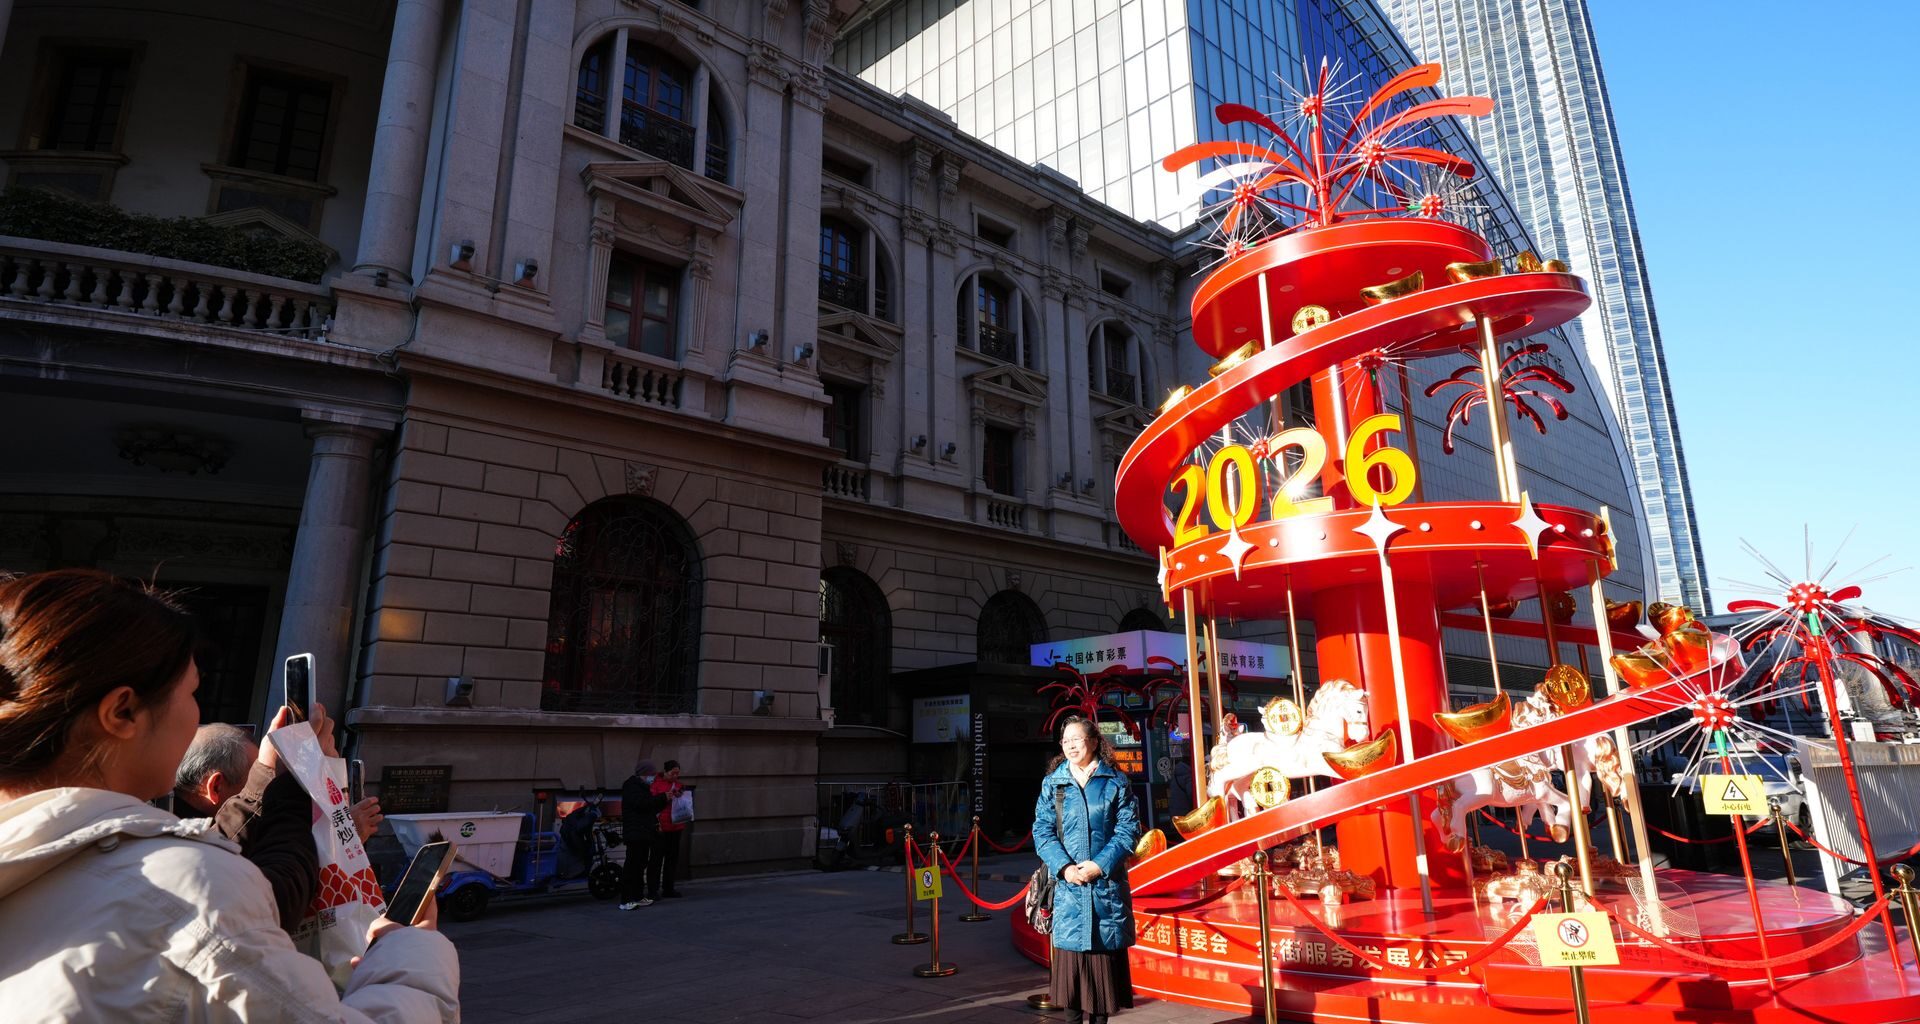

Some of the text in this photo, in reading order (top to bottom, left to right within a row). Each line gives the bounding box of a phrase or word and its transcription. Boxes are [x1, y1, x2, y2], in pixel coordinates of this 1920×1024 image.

[1171, 413, 1416, 548] 2026
[1065, 646, 1127, 665] 中国体育彩票
[1216, 652, 1265, 669] 国体育彩票
[971, 713, 986, 812] smoking area
[1722, 803, 1752, 811] 小心有电
[1256, 938, 1470, 975] 金街服务发展公司
[1561, 950, 1597, 961] 禁止攀爬
